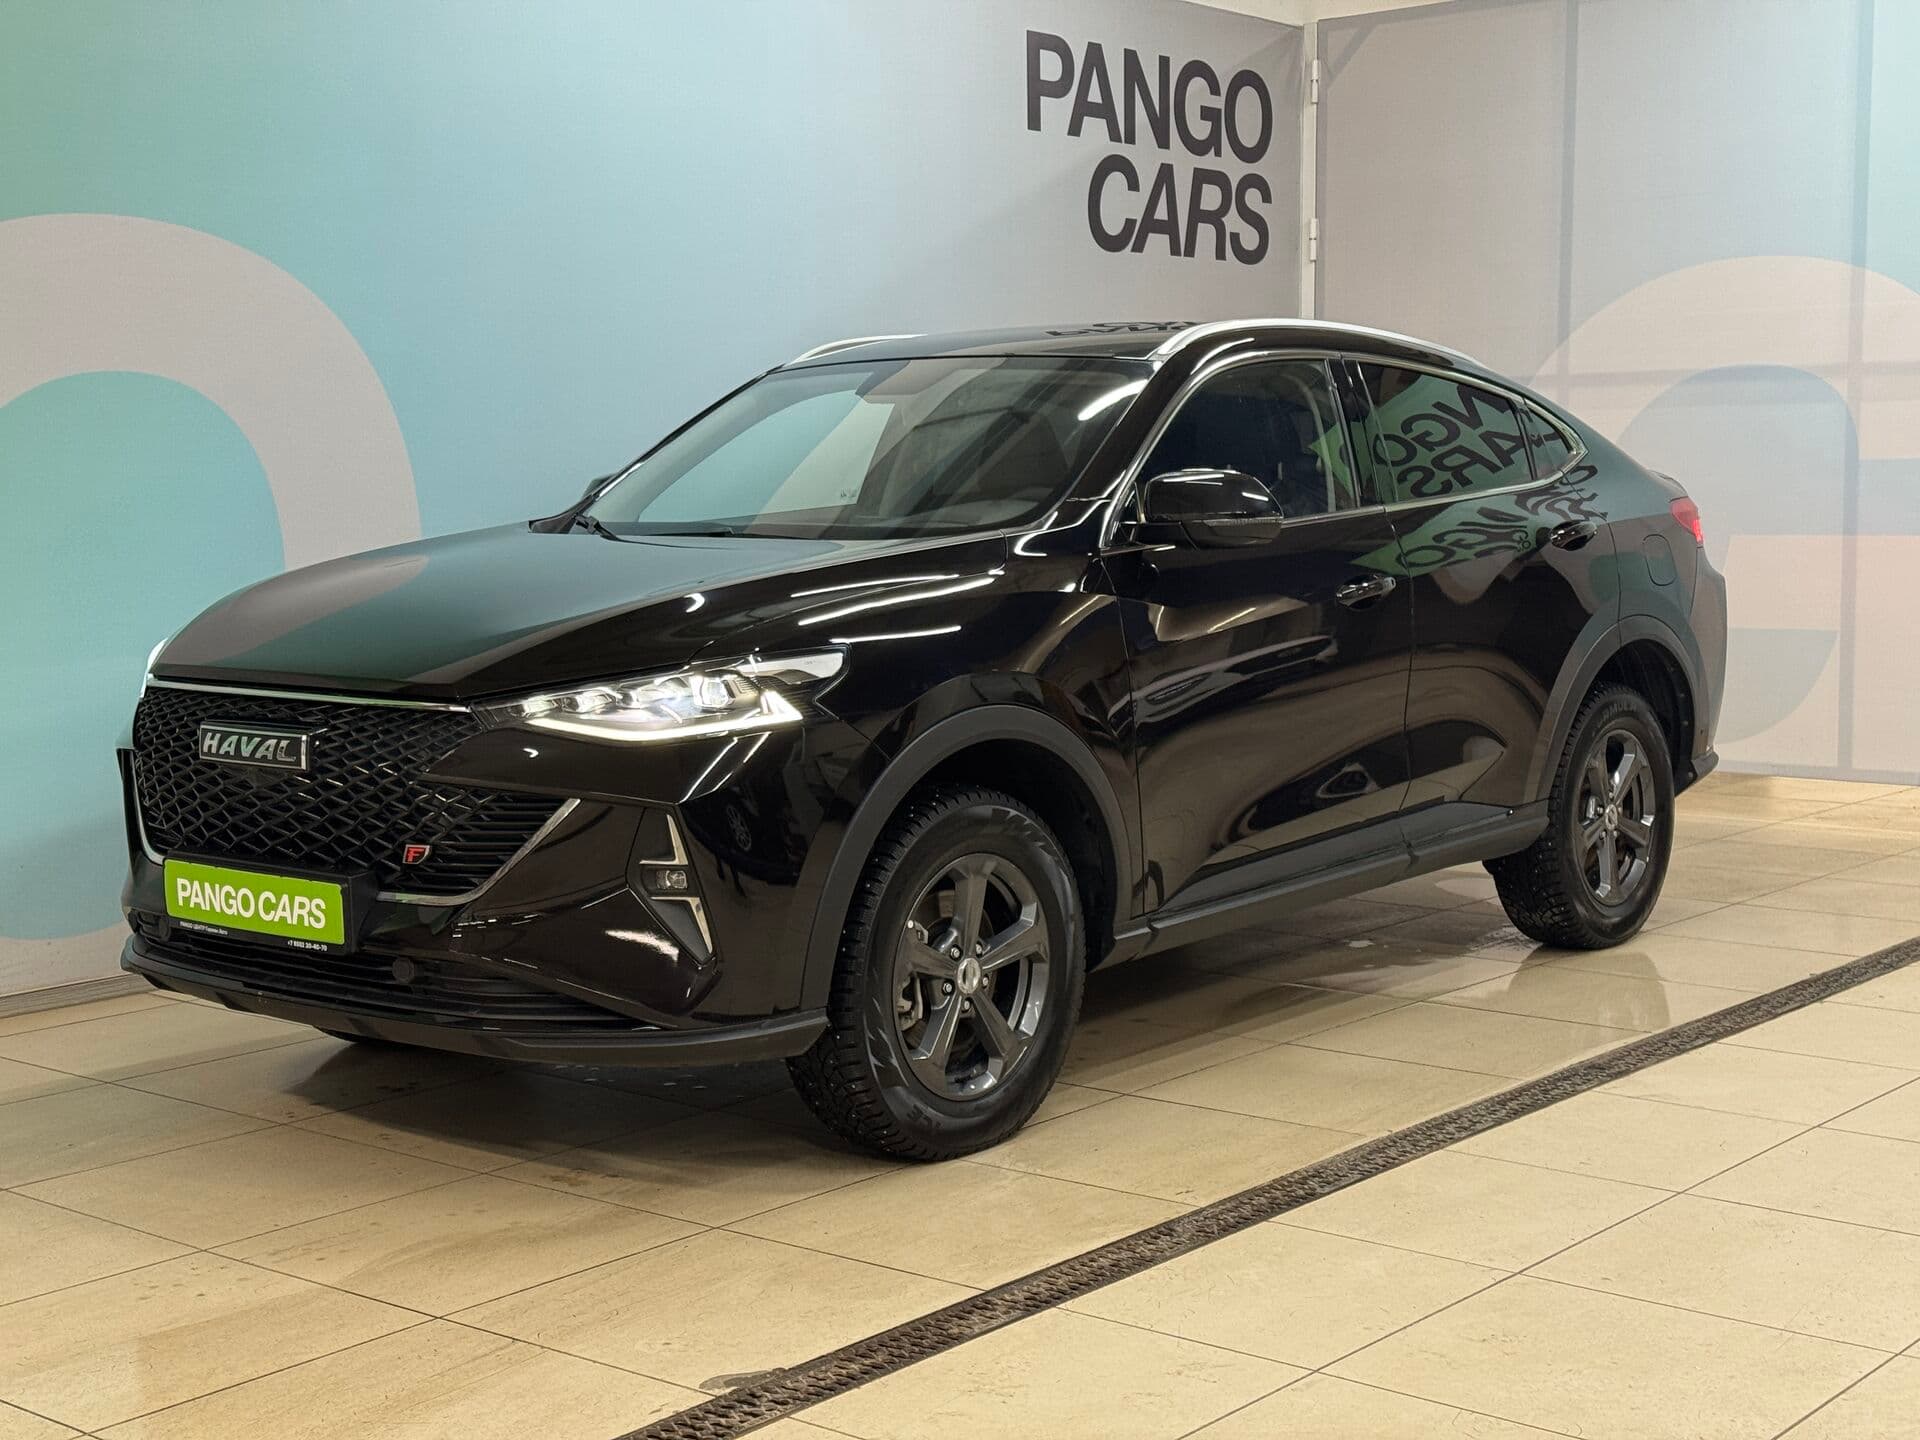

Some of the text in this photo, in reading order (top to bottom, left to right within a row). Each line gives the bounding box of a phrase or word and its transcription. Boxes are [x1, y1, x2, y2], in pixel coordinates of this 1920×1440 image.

[1026, 30, 1273, 164] PANGO
[1087, 154, 1273, 265] CARS
[202, 731, 297, 762] HAVAL
[176, 877, 326, 929] PANGO CARS
